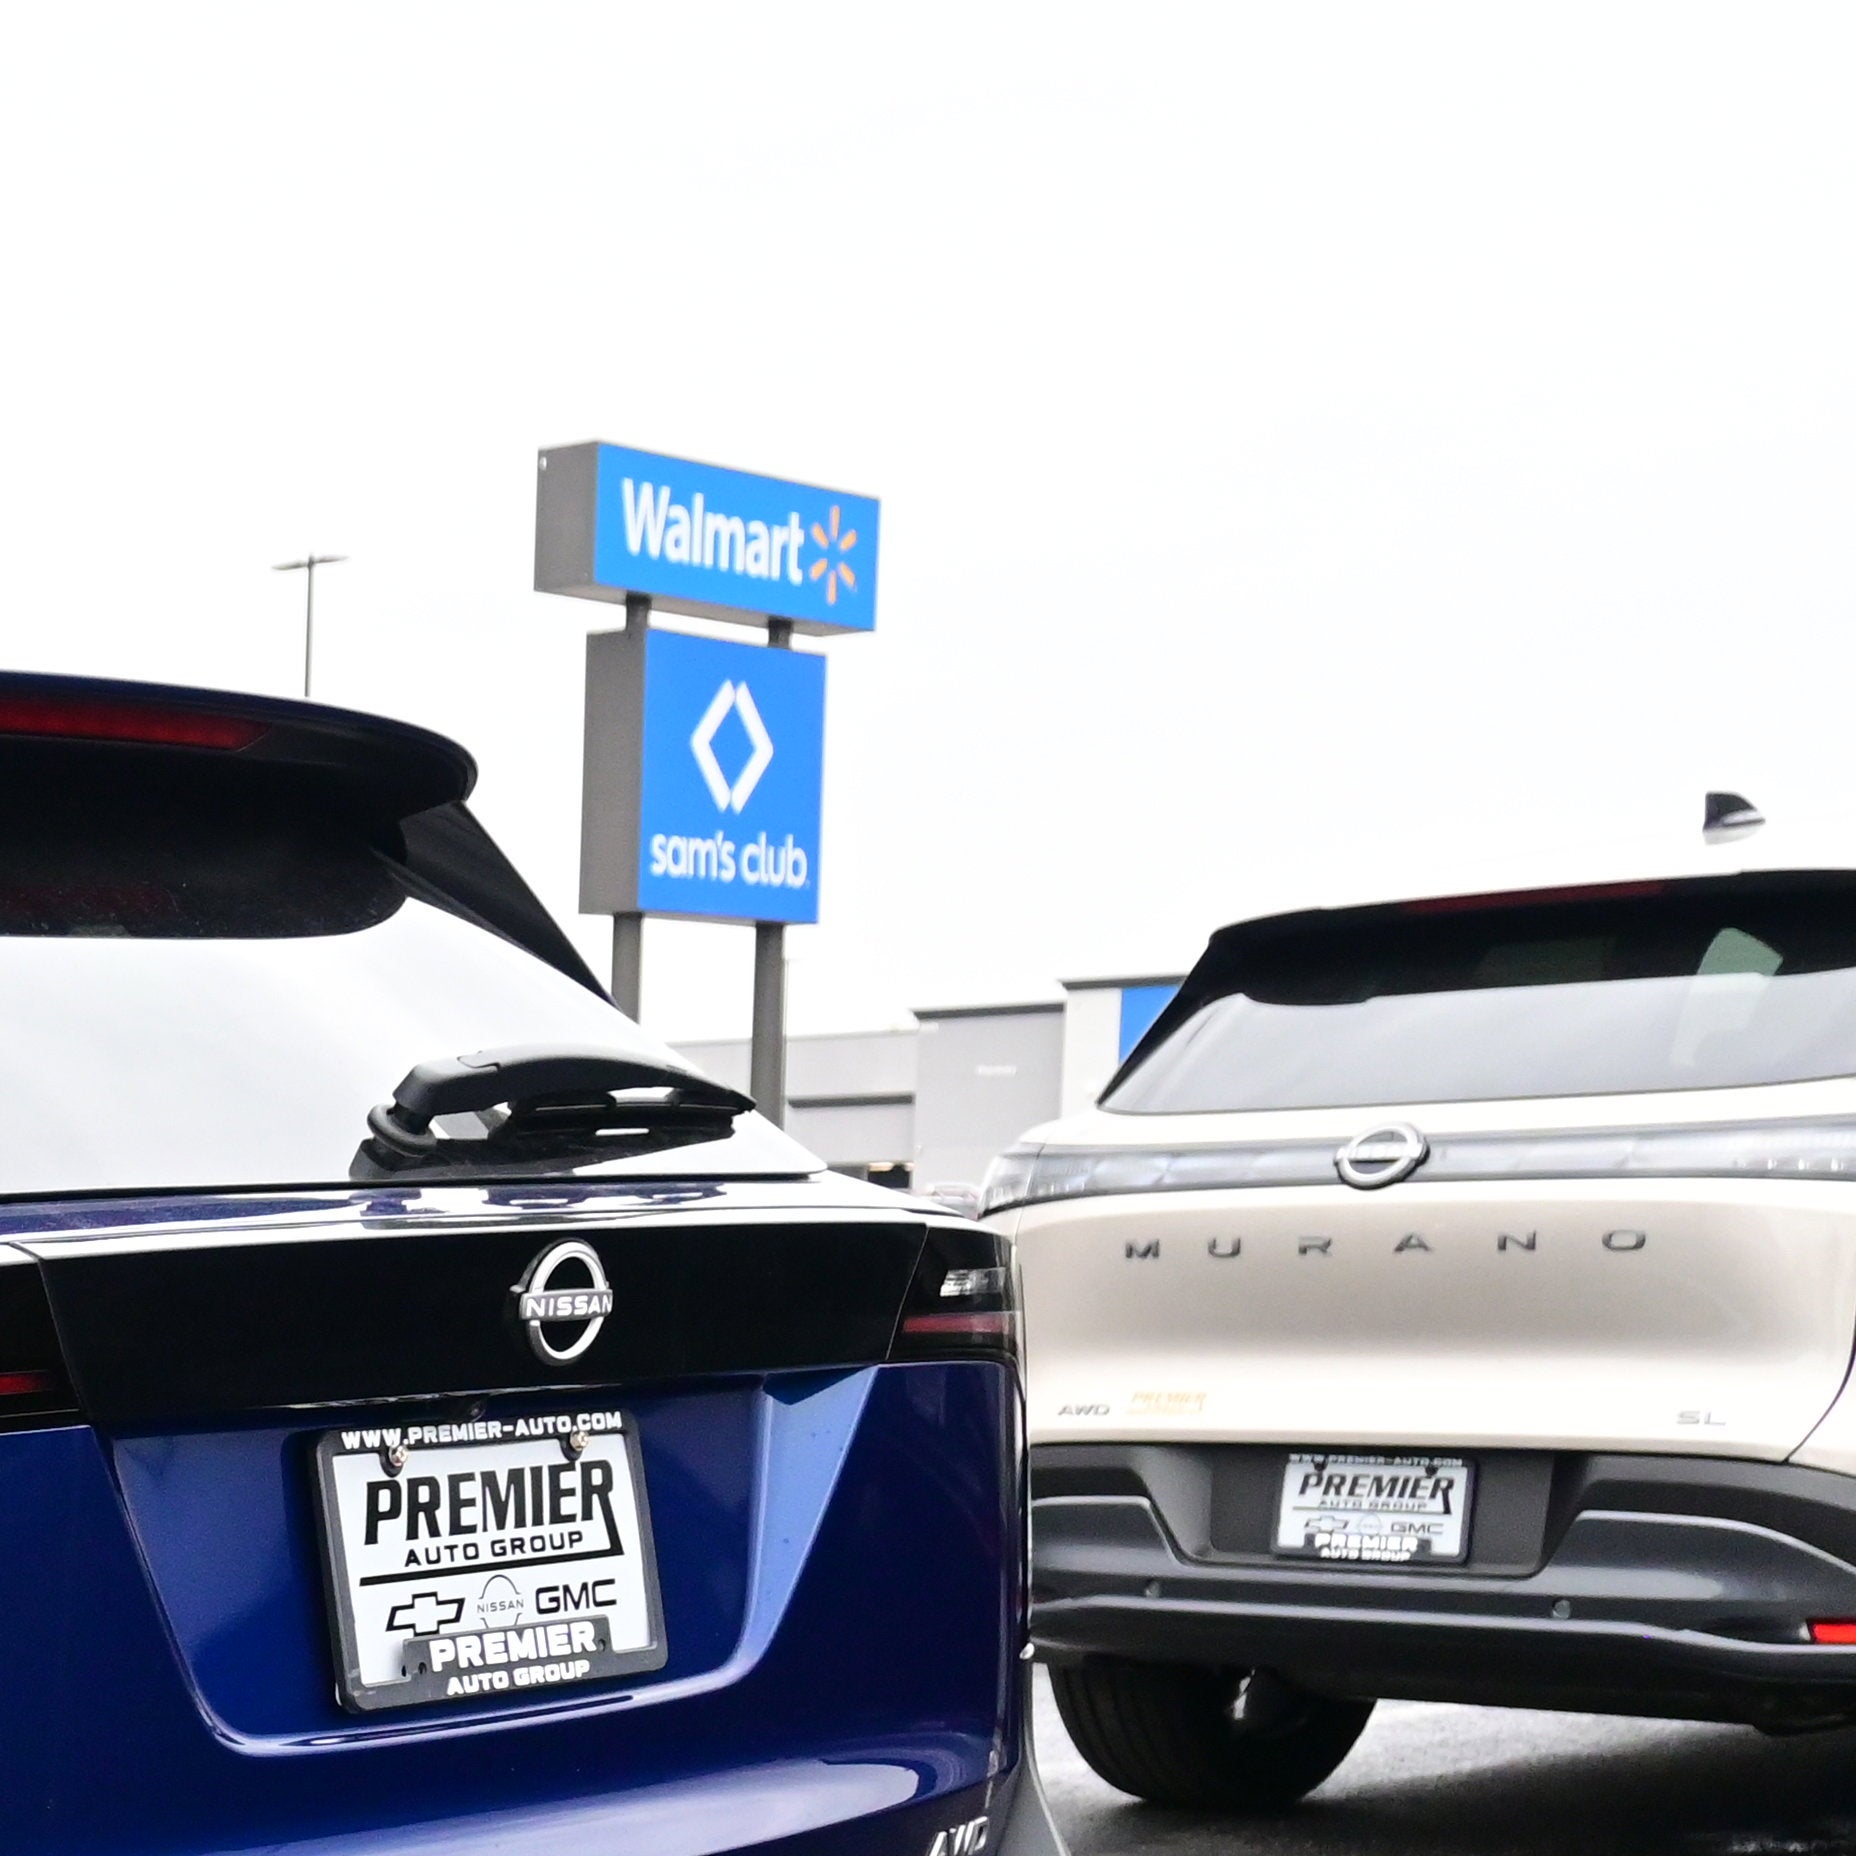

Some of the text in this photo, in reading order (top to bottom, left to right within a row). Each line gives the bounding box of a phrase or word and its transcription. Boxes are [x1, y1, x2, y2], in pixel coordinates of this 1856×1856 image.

[621, 477, 805, 586] Walmart
[650, 829, 807, 887] sam's club
[1124, 1227, 1648, 1261] MURANO
[526, 1294, 613, 1318] NISSAN
[1057, 1403, 1111, 1417] AWD
[1676, 1410, 1727, 1426] SL
[342, 1411, 622, 1450] WWW.PREMIER-AUTO.COM
[364, 1460, 624, 1555] PREMIER
[1298, 1472, 1455, 1512] PREMIER
[1318, 1500, 1428, 1511] AUTO GROUP
[1315, 1533, 1418, 1552] PREMIER
[1391, 1521, 1444, 1535] GMC
[405, 1531, 584, 1568] AUTO GROUP
[1320, 1547, 1412, 1562] AUTO GROUP
[476, 1578, 618, 1616] NISSAN GMC
[429, 1621, 597, 1674] PREMIER
[447, 1660, 591, 1696] AUTO GROUP
